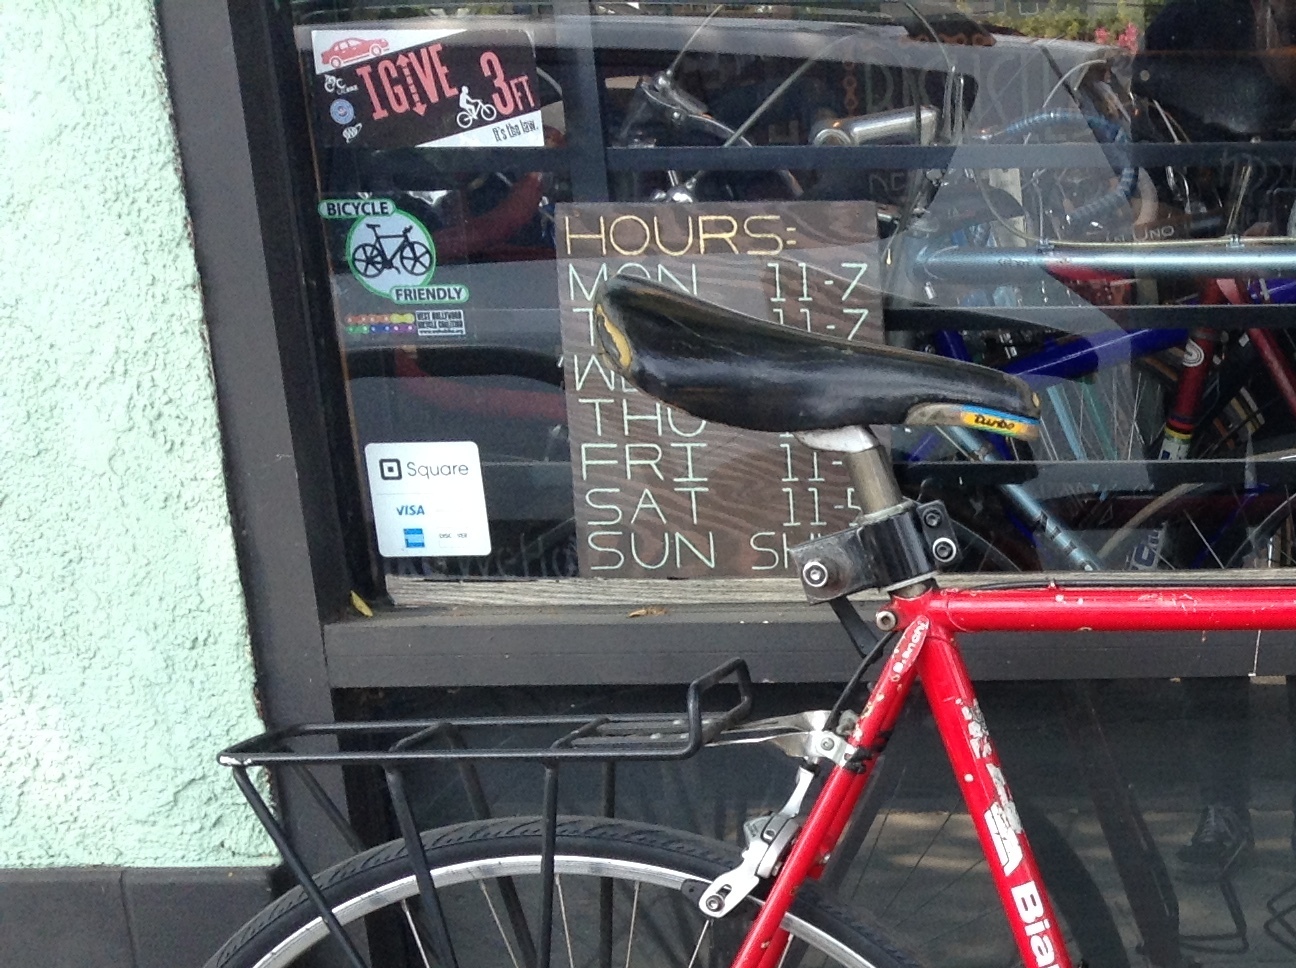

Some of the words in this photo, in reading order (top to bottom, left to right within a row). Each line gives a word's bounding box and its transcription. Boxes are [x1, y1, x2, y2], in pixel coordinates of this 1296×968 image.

[326, 201, 389, 216] BICYCLE
[565, 215, 797, 256] HOURS:
[395, 287, 463, 301] FRIENDLY
[767, 262, 868, 302] 11-7
[578, 398, 707, 438] THU
[974, 414, 1015, 430] Turbo
[406, 461, 469, 480] Square
[581, 443, 709, 481] FRI
[780, 443, 843, 482] 11-
[396, 504, 426, 516] VISA
[585, 488, 710, 526] SAT
[587, 531, 716, 570] SUN
